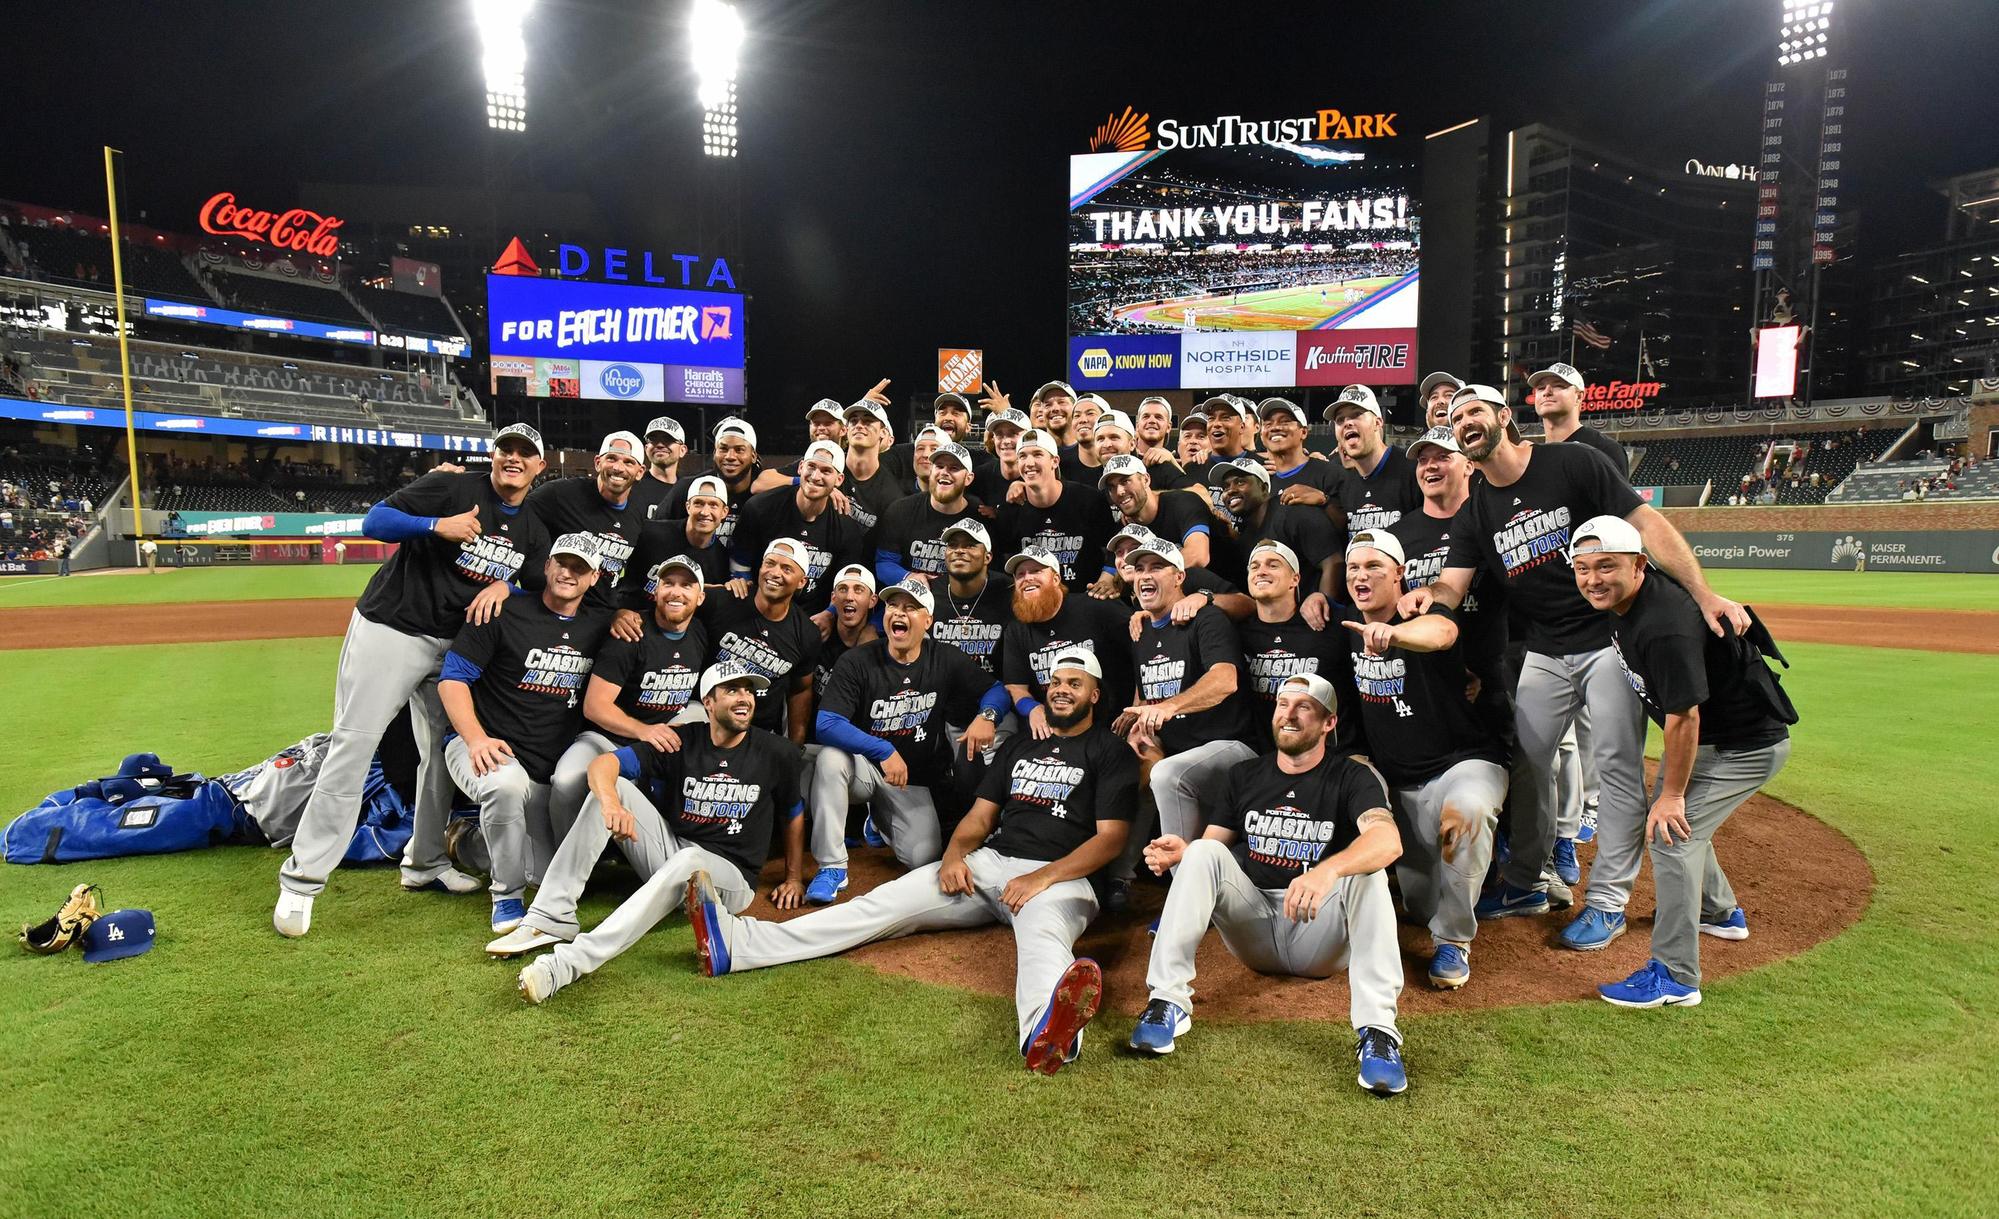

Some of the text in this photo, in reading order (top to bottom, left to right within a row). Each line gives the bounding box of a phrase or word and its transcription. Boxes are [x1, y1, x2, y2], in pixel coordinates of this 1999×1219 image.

[1761, 189, 1777, 198] 1914
[1090, 197, 1407, 241] THANK YOU, FANS!
[1760, 206, 1776, 215] 1957
[559, 243, 736, 288] DELTA
[502, 305, 699, 348] FOR EACH OTHER
[1083, 354, 1172, 370] NAPA KNOW HOW
[1187, 349, 1291, 363] NORTHSIDE
[1304, 344, 1408, 370] Kauffman TIRE
[940, 350, 982, 392] HOME
[1205, 364, 1271, 374] HOSPITAL
[604, 370, 641, 396] Kroger
[684, 380, 724, 389] CHEROKEE
[684, 387, 724, 395] CASINOS
[1580, 398, 1644, 412] BORHOOD
[1493, 506, 1571, 554] CHASING
[1693, 545, 1792, 560] Georgia Power
[1871, 544, 1906, 553] KAISER
[7, 563, 26, 571] Bat
[1870, 555, 1943, 565] PERMANENTE
[933, 621, 1002, 640] CHASING
[524, 648, 594, 674] CHASING
[719, 631, 793, 675] CHASING
[980, 656, 993, 672] LA
[1249, 657, 1319, 677] HASING
[640, 671, 699, 690] CHASIN
[567, 689, 578, 708] LA
[870, 691, 937, 719] CHASING
[1391, 696, 1414, 717] LA
[914, 725, 927, 743] LA
[1011, 759, 1085, 785] CHASING
[682, 777, 761, 802] CHASING
[1051, 800, 1067, 818] LA
[727, 819, 743, 835] LA
[1244, 810, 1335, 841] CHASING
[108, 923, 124, 941] LA
